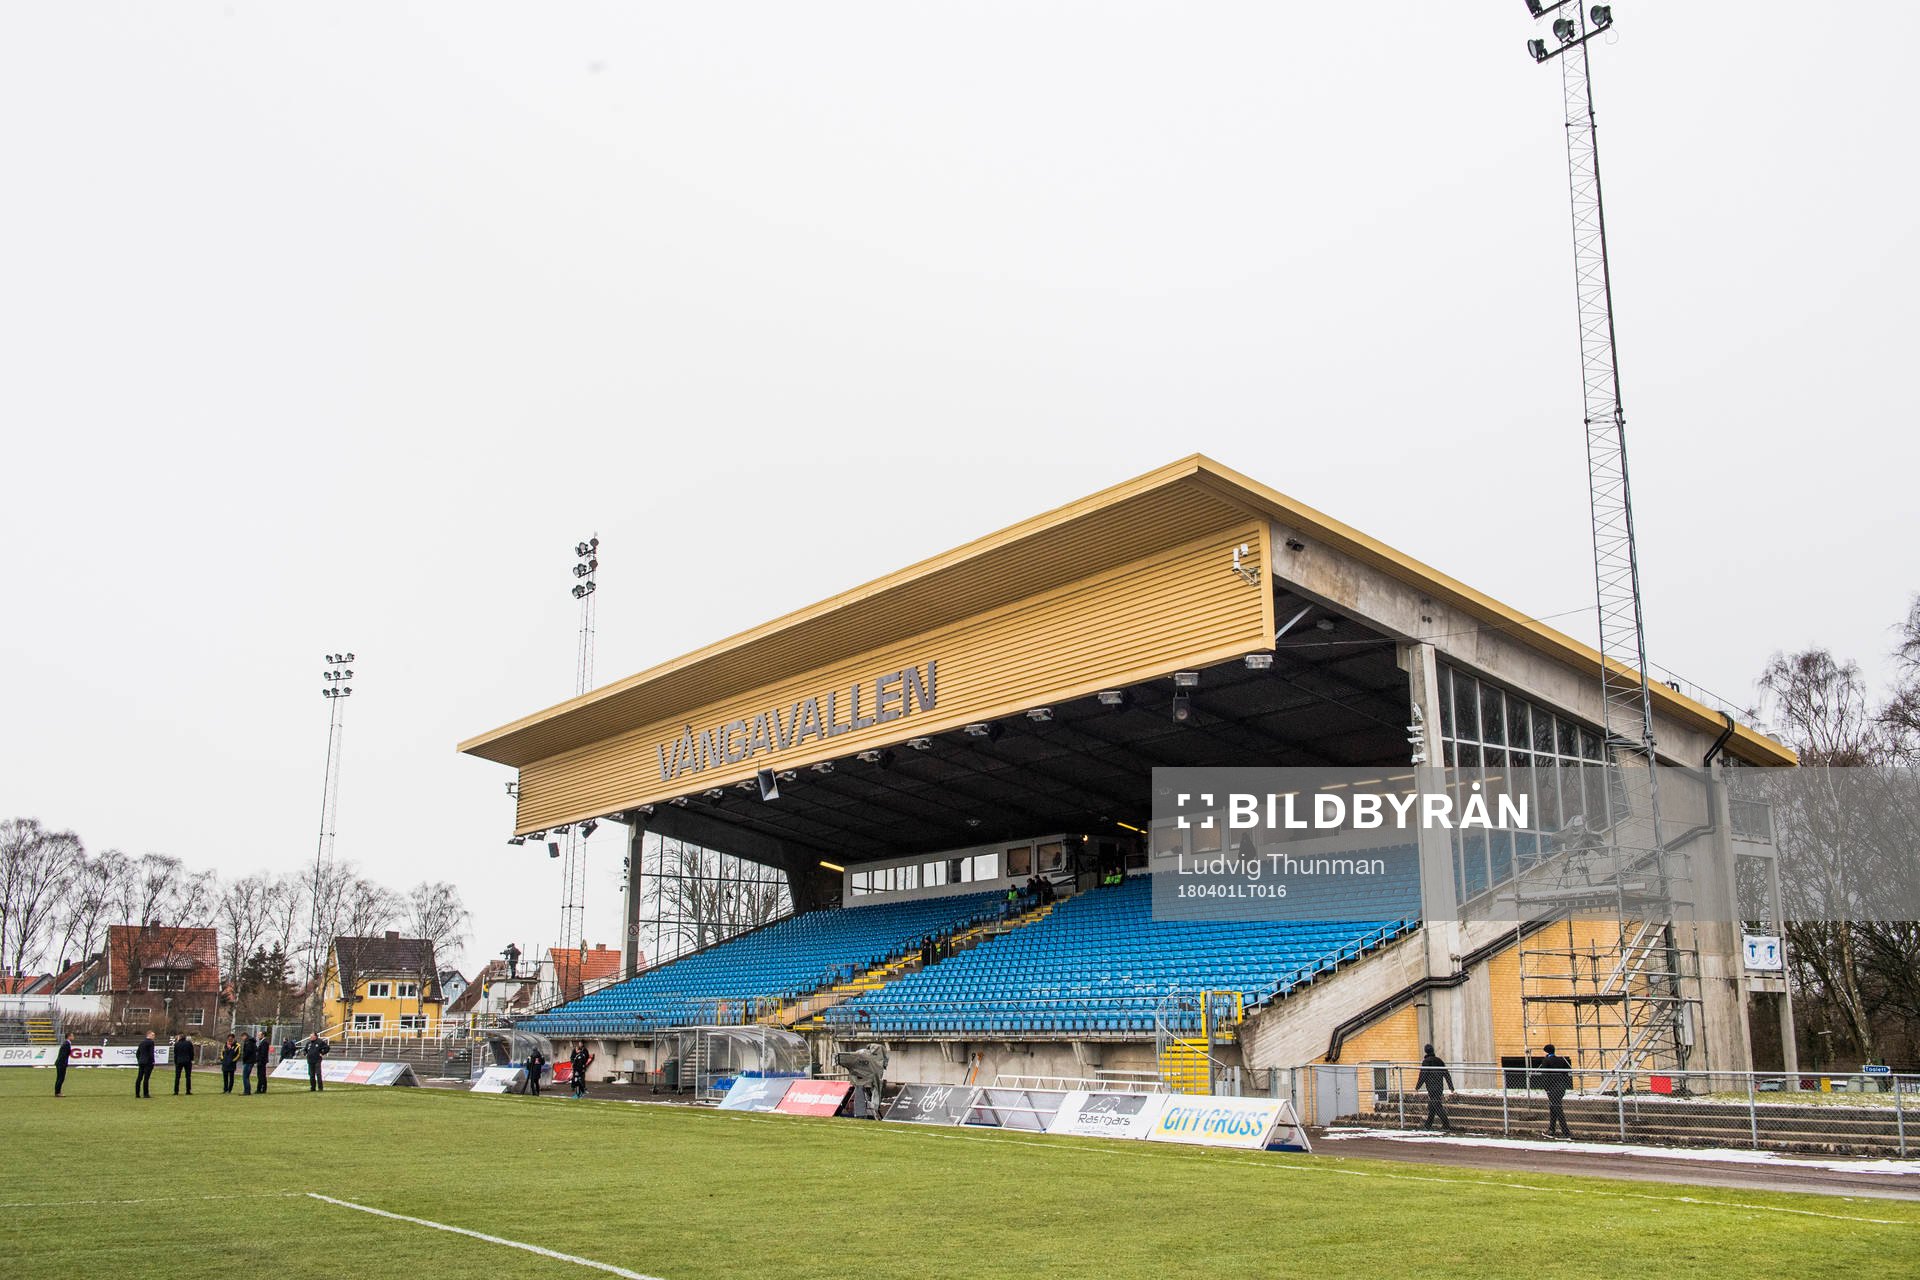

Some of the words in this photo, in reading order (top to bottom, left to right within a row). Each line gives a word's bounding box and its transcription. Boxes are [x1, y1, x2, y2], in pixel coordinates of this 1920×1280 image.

[656, 660, 937, 782] VÅNGAVALLEN
[3, 1050, 32, 1059] BRA
[70, 1048, 103, 1059] GdR
